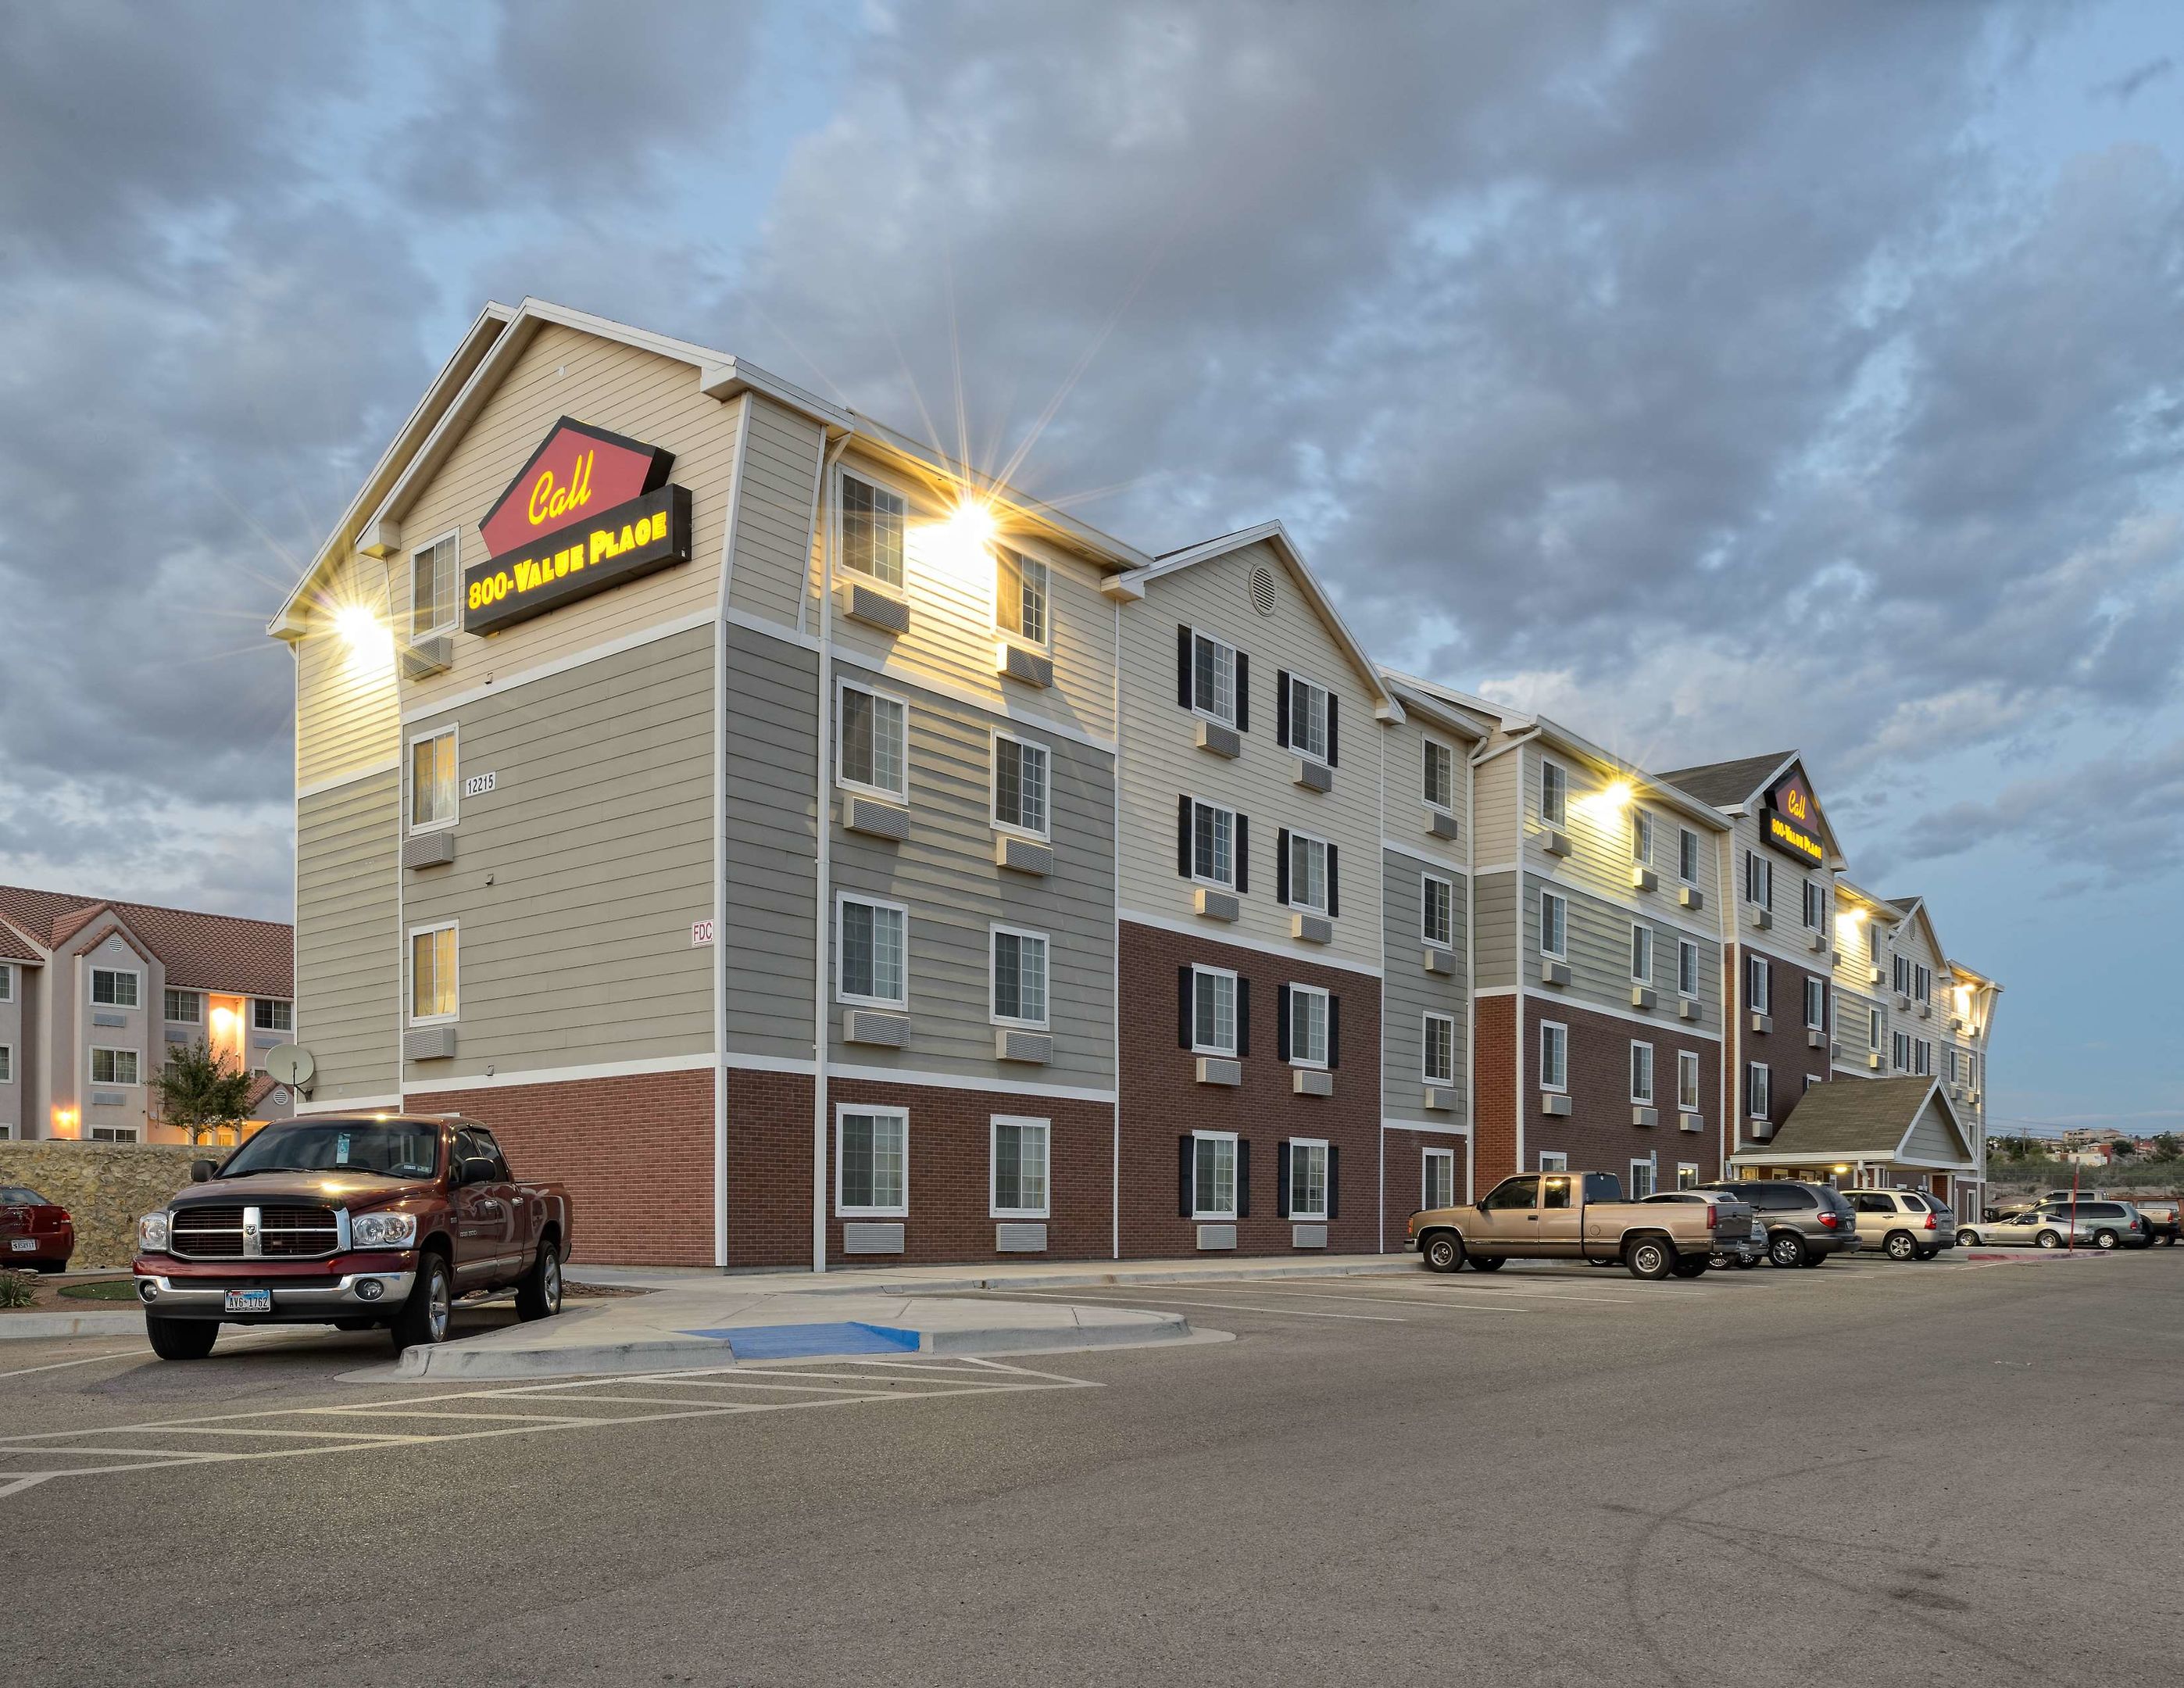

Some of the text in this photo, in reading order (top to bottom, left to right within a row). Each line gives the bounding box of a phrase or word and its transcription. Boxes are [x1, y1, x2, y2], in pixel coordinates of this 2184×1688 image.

[527, 449, 594, 525] Call
[468, 774, 493, 794] 12215
[1788, 789, 1806, 820] Call
[694, 922, 712, 941] FDC
